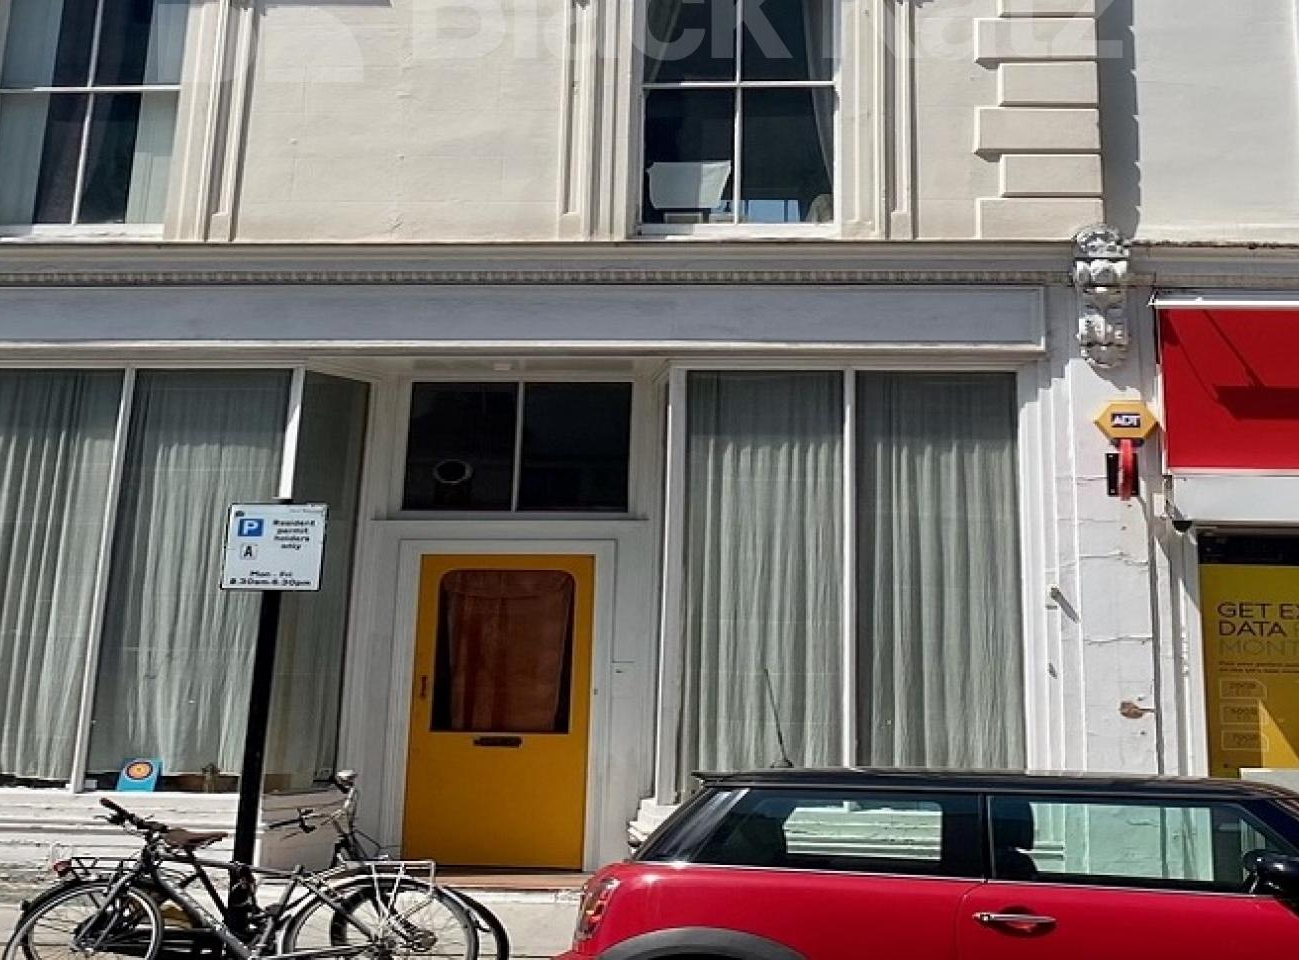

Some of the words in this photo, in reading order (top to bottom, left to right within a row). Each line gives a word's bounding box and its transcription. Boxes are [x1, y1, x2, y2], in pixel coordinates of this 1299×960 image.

[1112, 415, 1140, 426] ADT
[243, 520, 259, 535] P
[243, 545, 253, 557] A
[1217, 602, 1272, 619] GET
[1219, 621, 1287, 637] DATA
